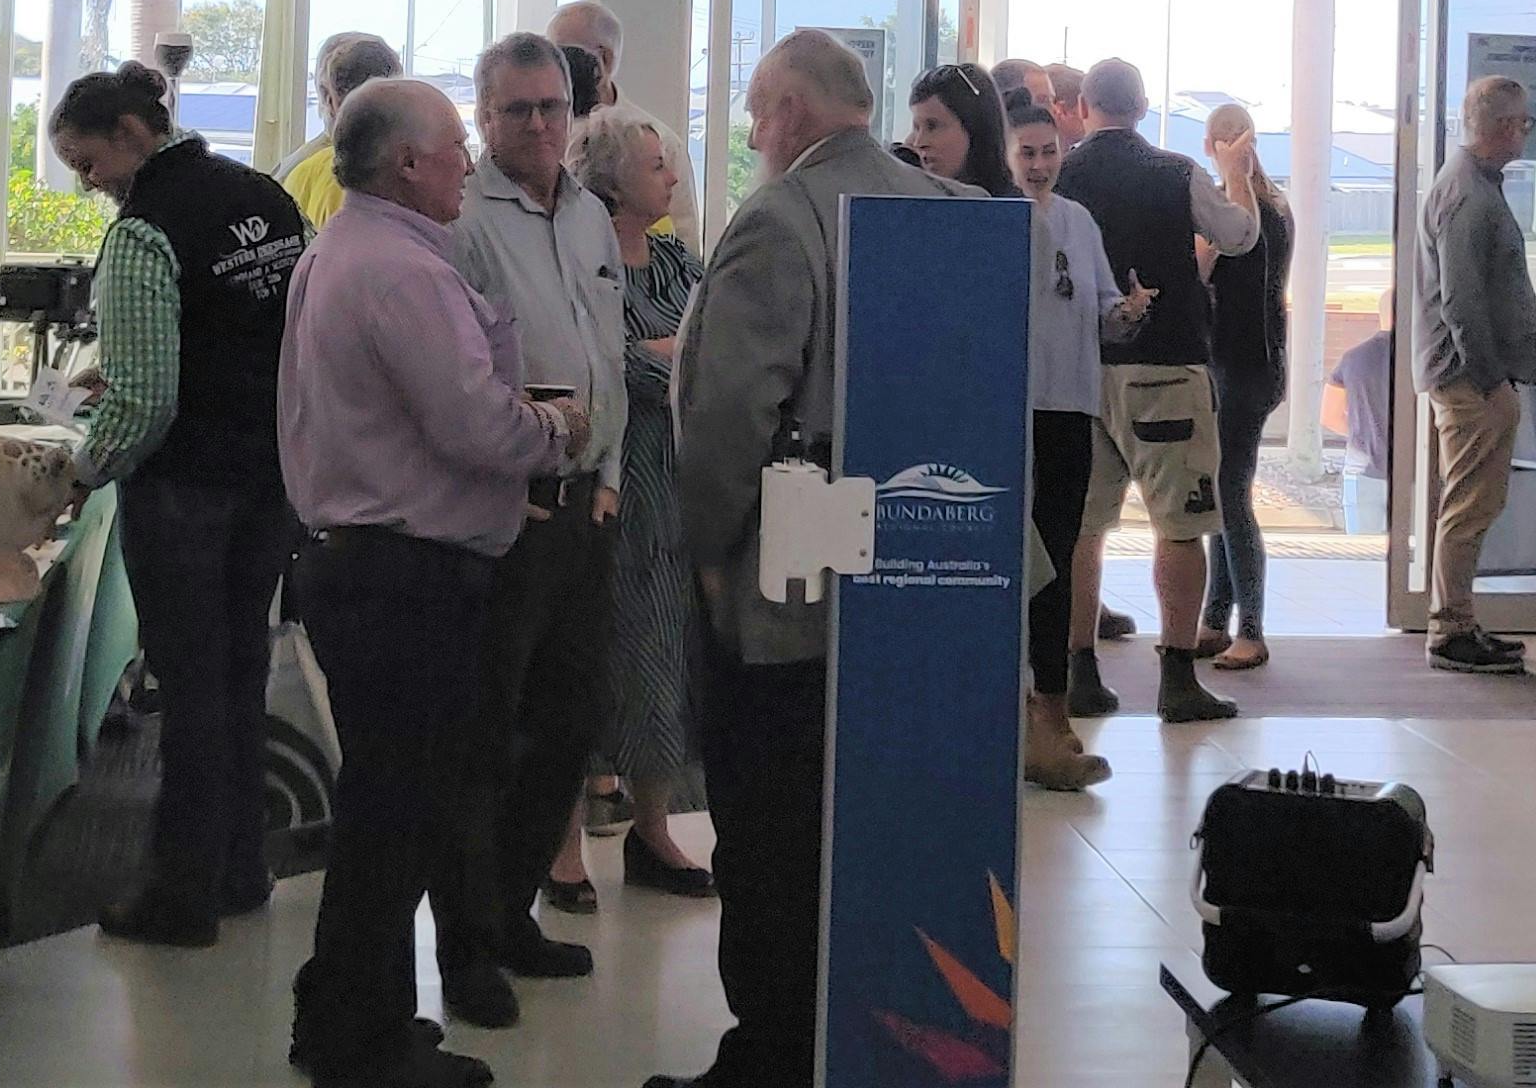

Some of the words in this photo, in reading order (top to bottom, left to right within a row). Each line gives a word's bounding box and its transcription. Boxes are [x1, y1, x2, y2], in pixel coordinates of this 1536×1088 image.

[876, 504, 994, 522] BUNDABERG
[882, 574, 937, 588] regional
[937, 574, 1011, 589] community
